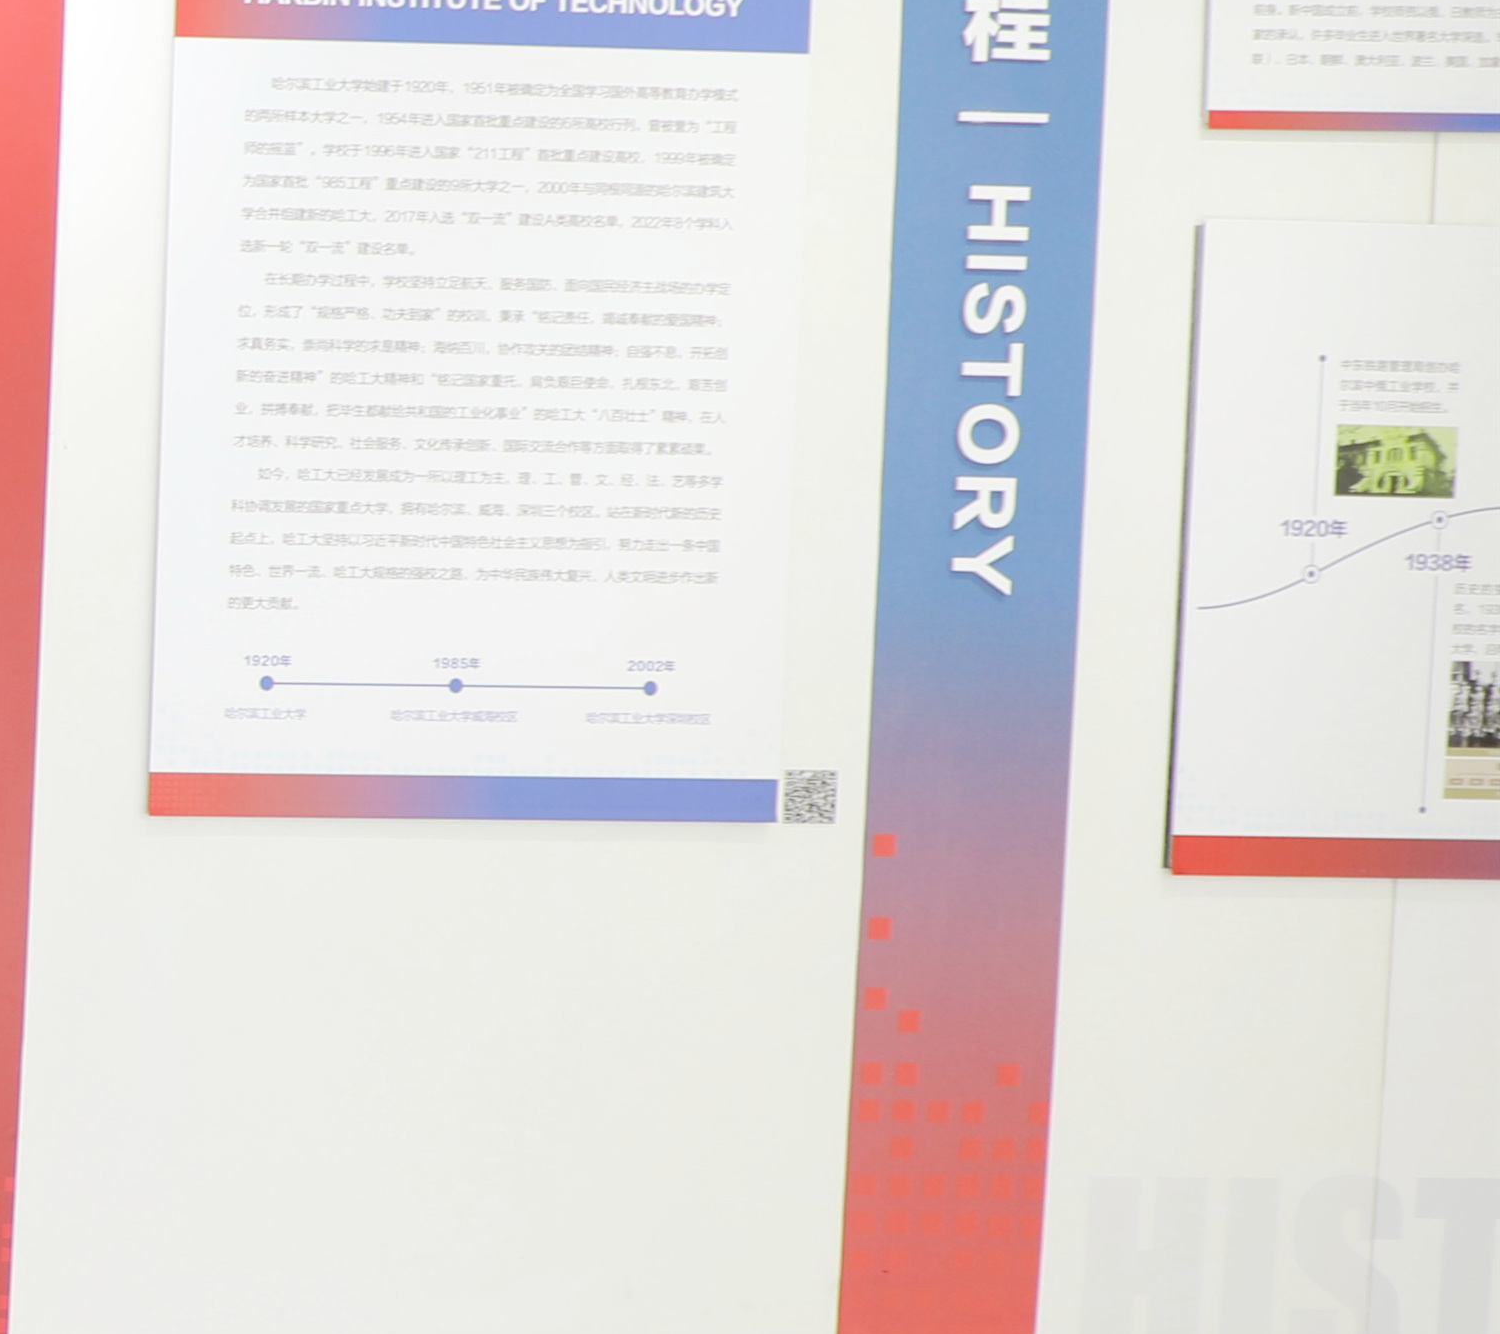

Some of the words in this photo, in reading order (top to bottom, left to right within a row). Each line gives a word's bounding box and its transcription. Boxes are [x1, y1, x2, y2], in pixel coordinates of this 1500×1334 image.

[950, 184, 1033, 597] HISTORY
[1280, 518, 1350, 539] 1920年
[1405, 553, 1473, 573] 1938年
[243, 654, 292, 667] 1920年
[433, 657, 481, 670] 1985年
[627, 660, 675, 672] 2002年
